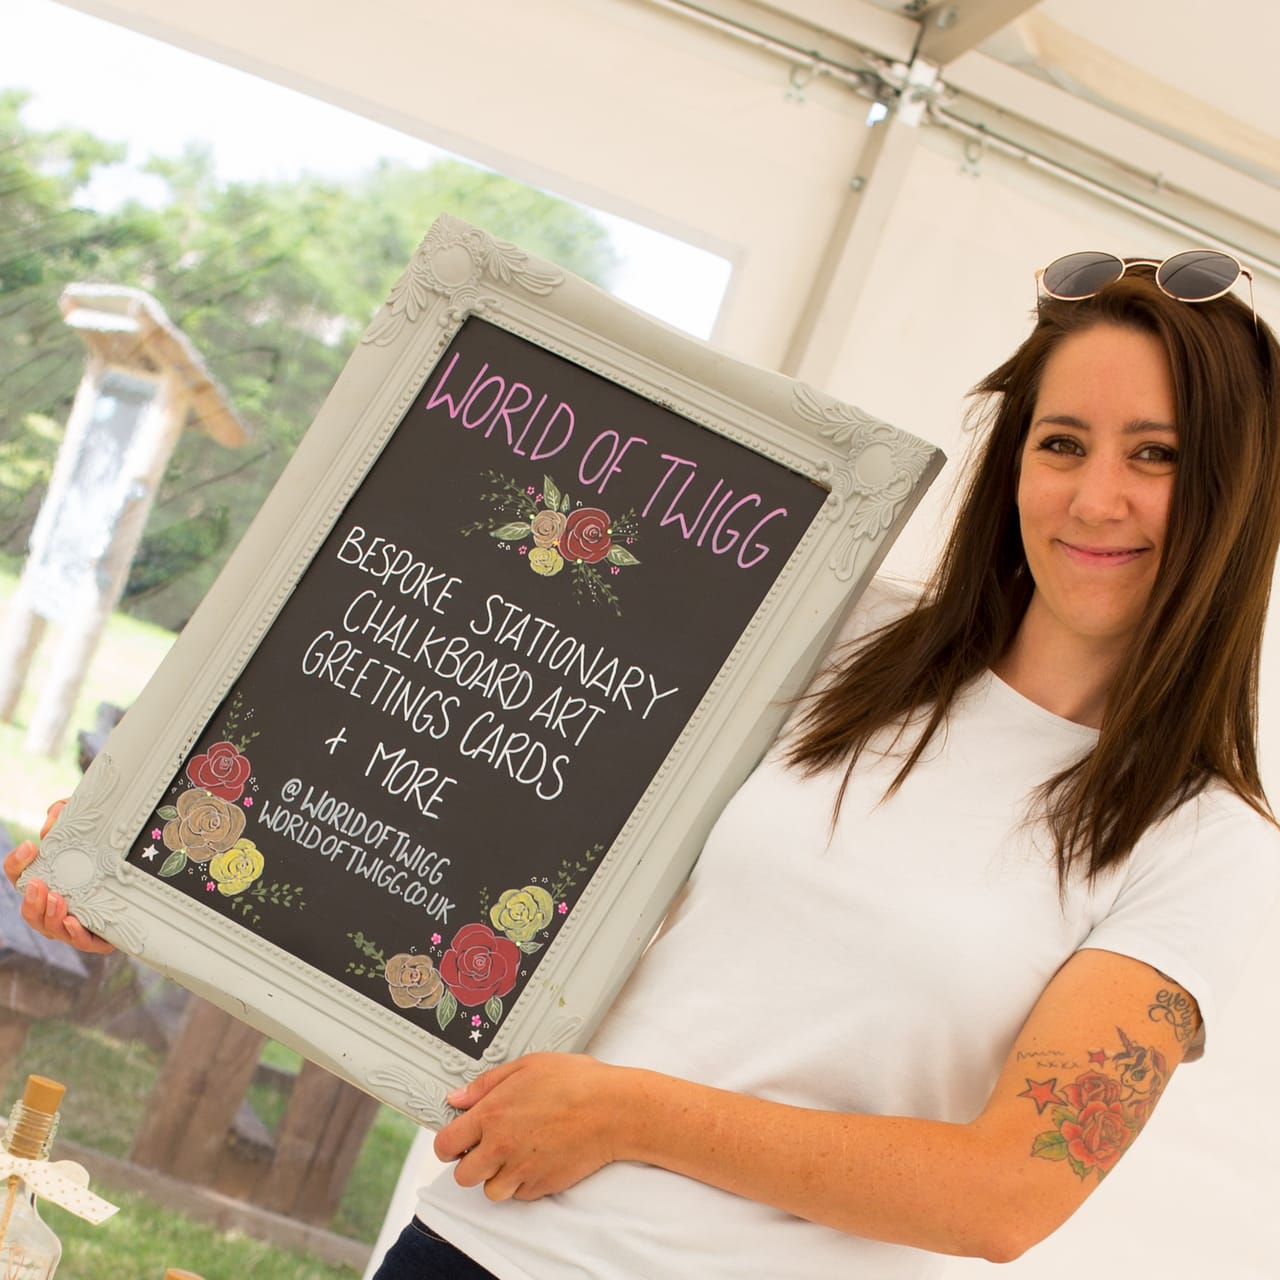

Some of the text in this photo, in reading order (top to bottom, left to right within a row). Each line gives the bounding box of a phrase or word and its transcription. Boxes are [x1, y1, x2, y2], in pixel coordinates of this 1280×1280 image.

[425, 351, 788, 569] WORLD OF TWIGG
[336, 525, 680, 720] BESPOKE STATIONARY
[342, 589, 607, 747] CHALKBOARD ART
[301, 630, 570, 801] GREETINGS CARDS
[364, 742, 458, 820] MORE
